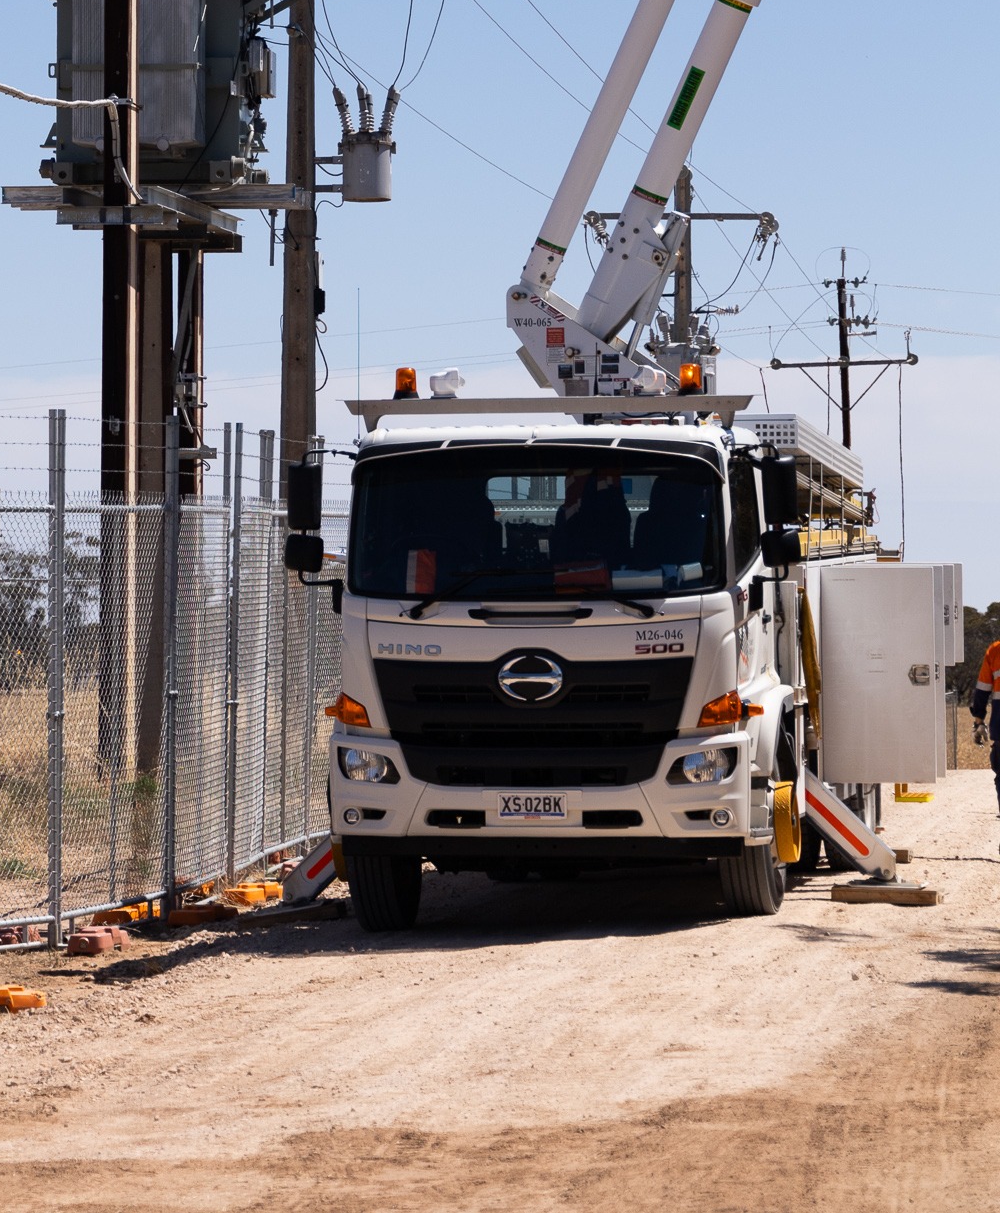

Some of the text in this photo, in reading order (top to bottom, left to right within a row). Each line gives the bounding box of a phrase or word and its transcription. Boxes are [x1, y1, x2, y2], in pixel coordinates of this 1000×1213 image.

[514, 318, 552, 328] W40-065
[635, 629, 684, 641] M26-046
[377, 643, 442, 656] HINO
[635, 643, 685, 654] 500
